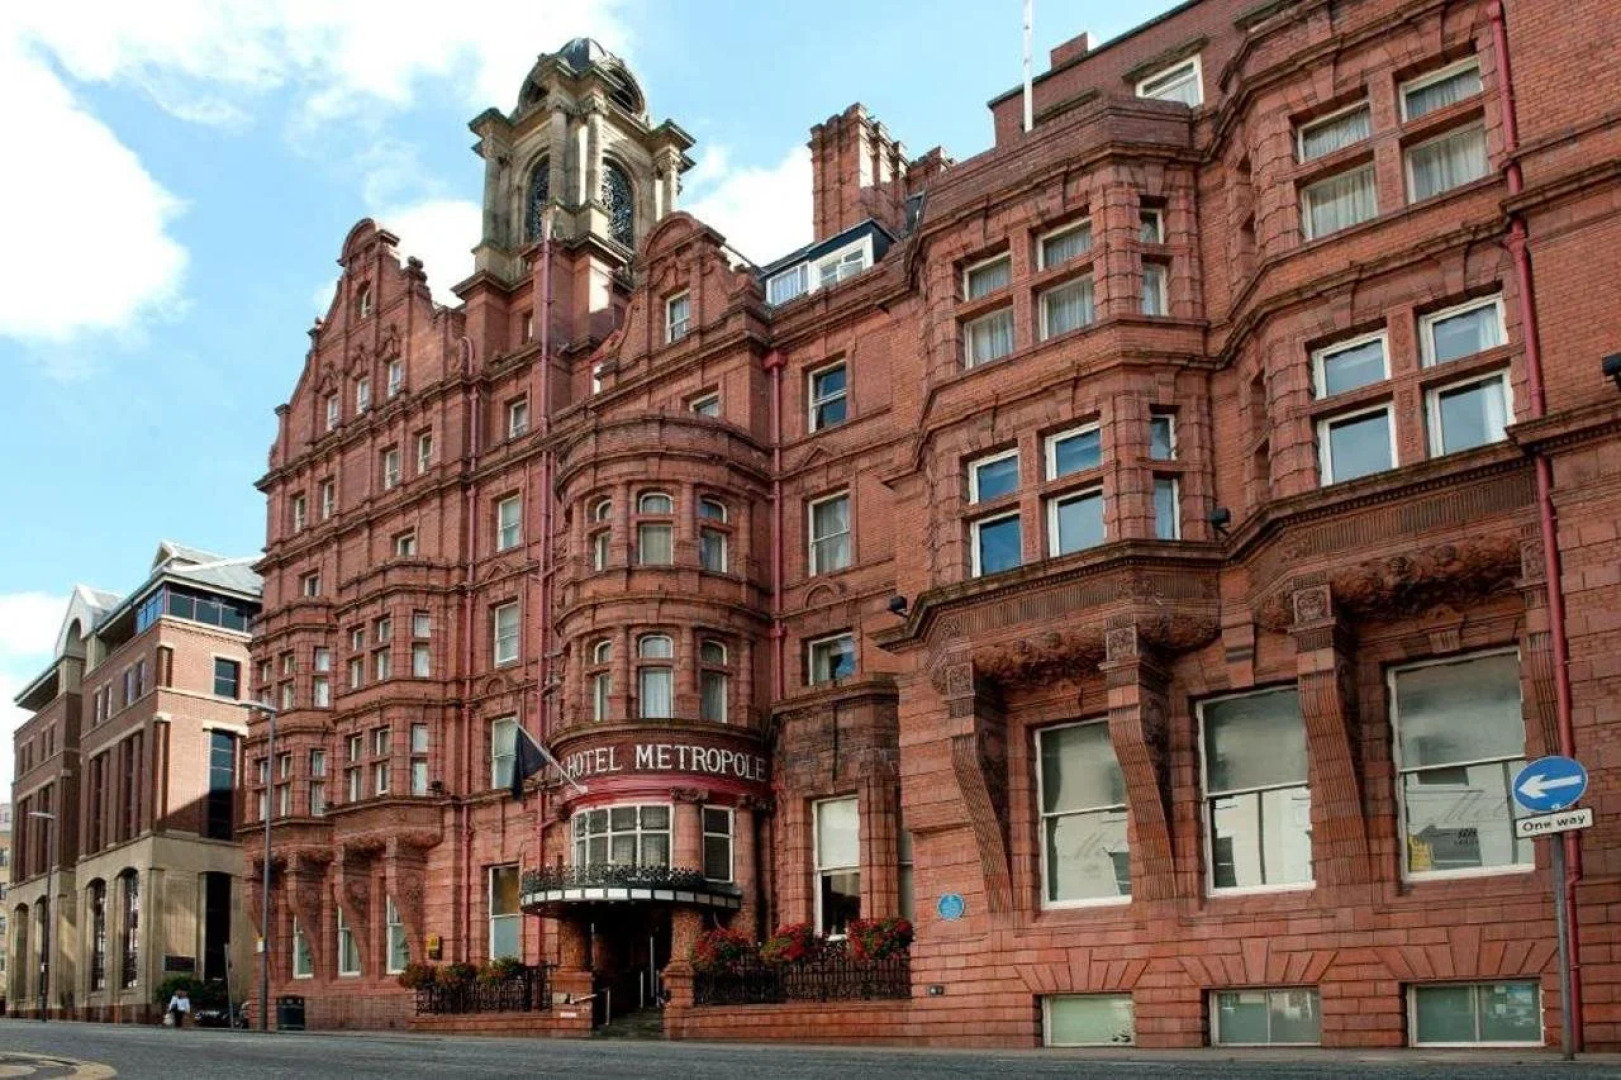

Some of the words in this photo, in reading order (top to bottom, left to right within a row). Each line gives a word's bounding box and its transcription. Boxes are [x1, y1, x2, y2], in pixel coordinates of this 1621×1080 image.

[565, 747, 623, 779] HOTEL
[635, 744, 767, 782] METROPOLE
[1521, 821, 1552, 832] One
[1557, 814, 1585, 826] way
